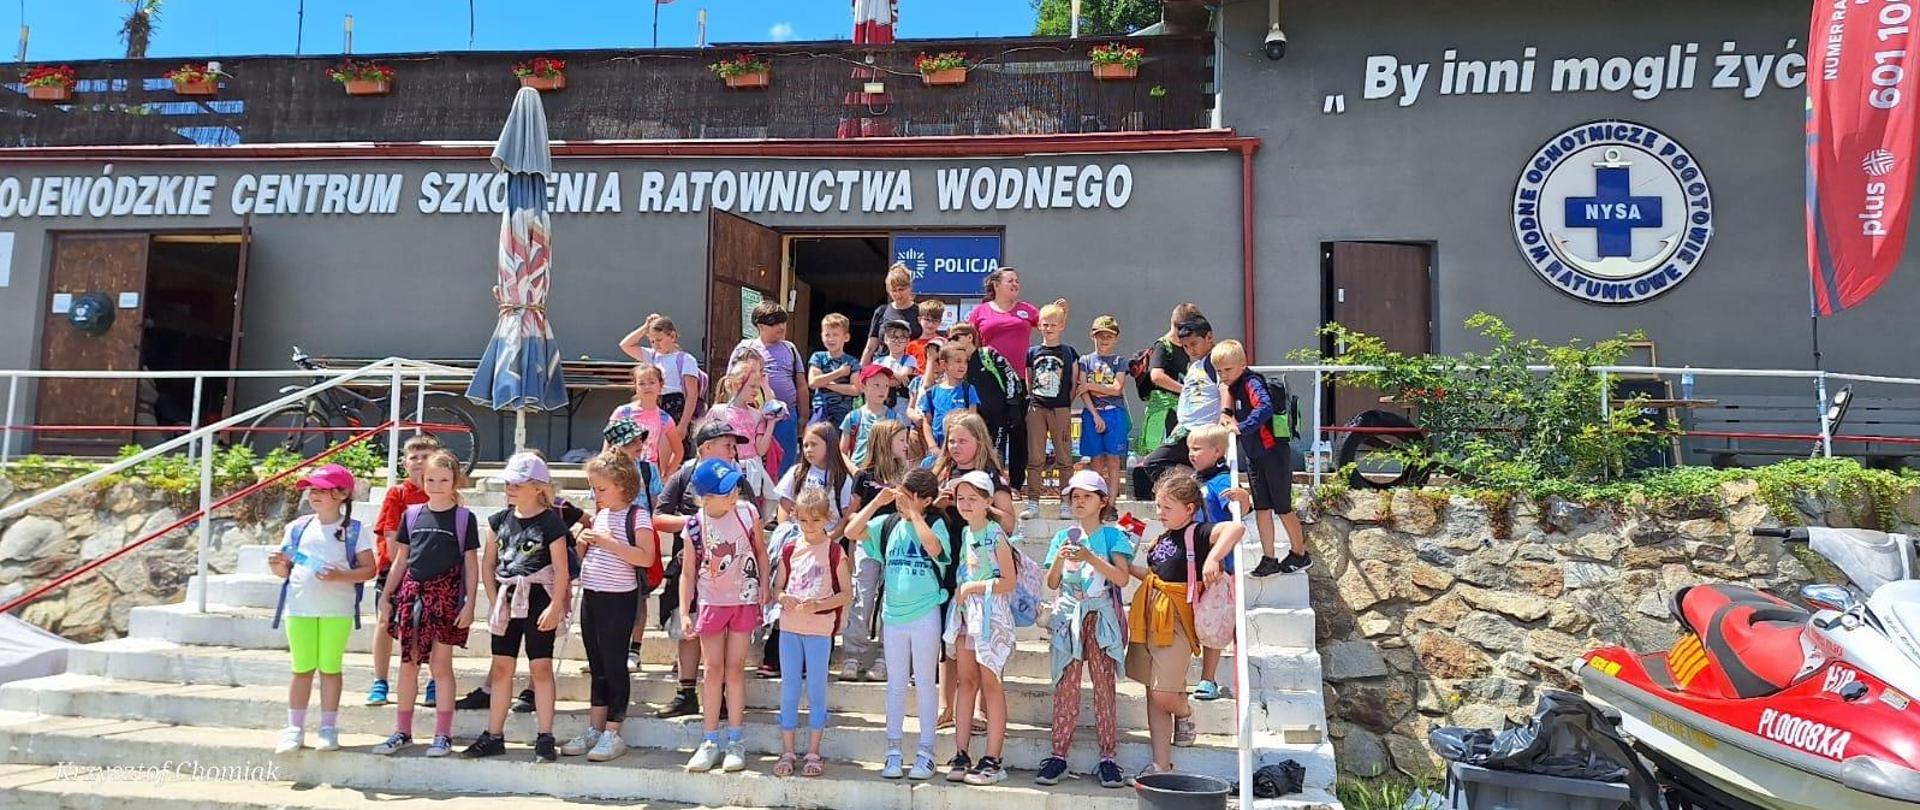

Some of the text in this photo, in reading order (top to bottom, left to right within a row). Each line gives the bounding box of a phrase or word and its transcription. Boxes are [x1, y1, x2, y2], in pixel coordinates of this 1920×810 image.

[1363, 55, 1430, 107] By
[1440, 47, 1537, 95] inni
[1551, 43, 1699, 100] mogli
[1712, 38, 1807, 98] żyć
[1823, 23, 1845, 80] NUMER
[1868, 0, 1912, 109] 601 10
[0, 163, 1133, 218] OJEWÓDZKIE CENTRUM SZKONIA RATOWNICTWA WODNEGO
[1518, 124, 1710, 266] WODNE OCHOTNICZE POGOTOWIE
[1585, 203, 1641, 220] NYSA
[1858, 181, 1887, 237] plus
[934, 257, 998, 273] POLICJA
[1545, 264, 1683, 300] RATUNKOWE
